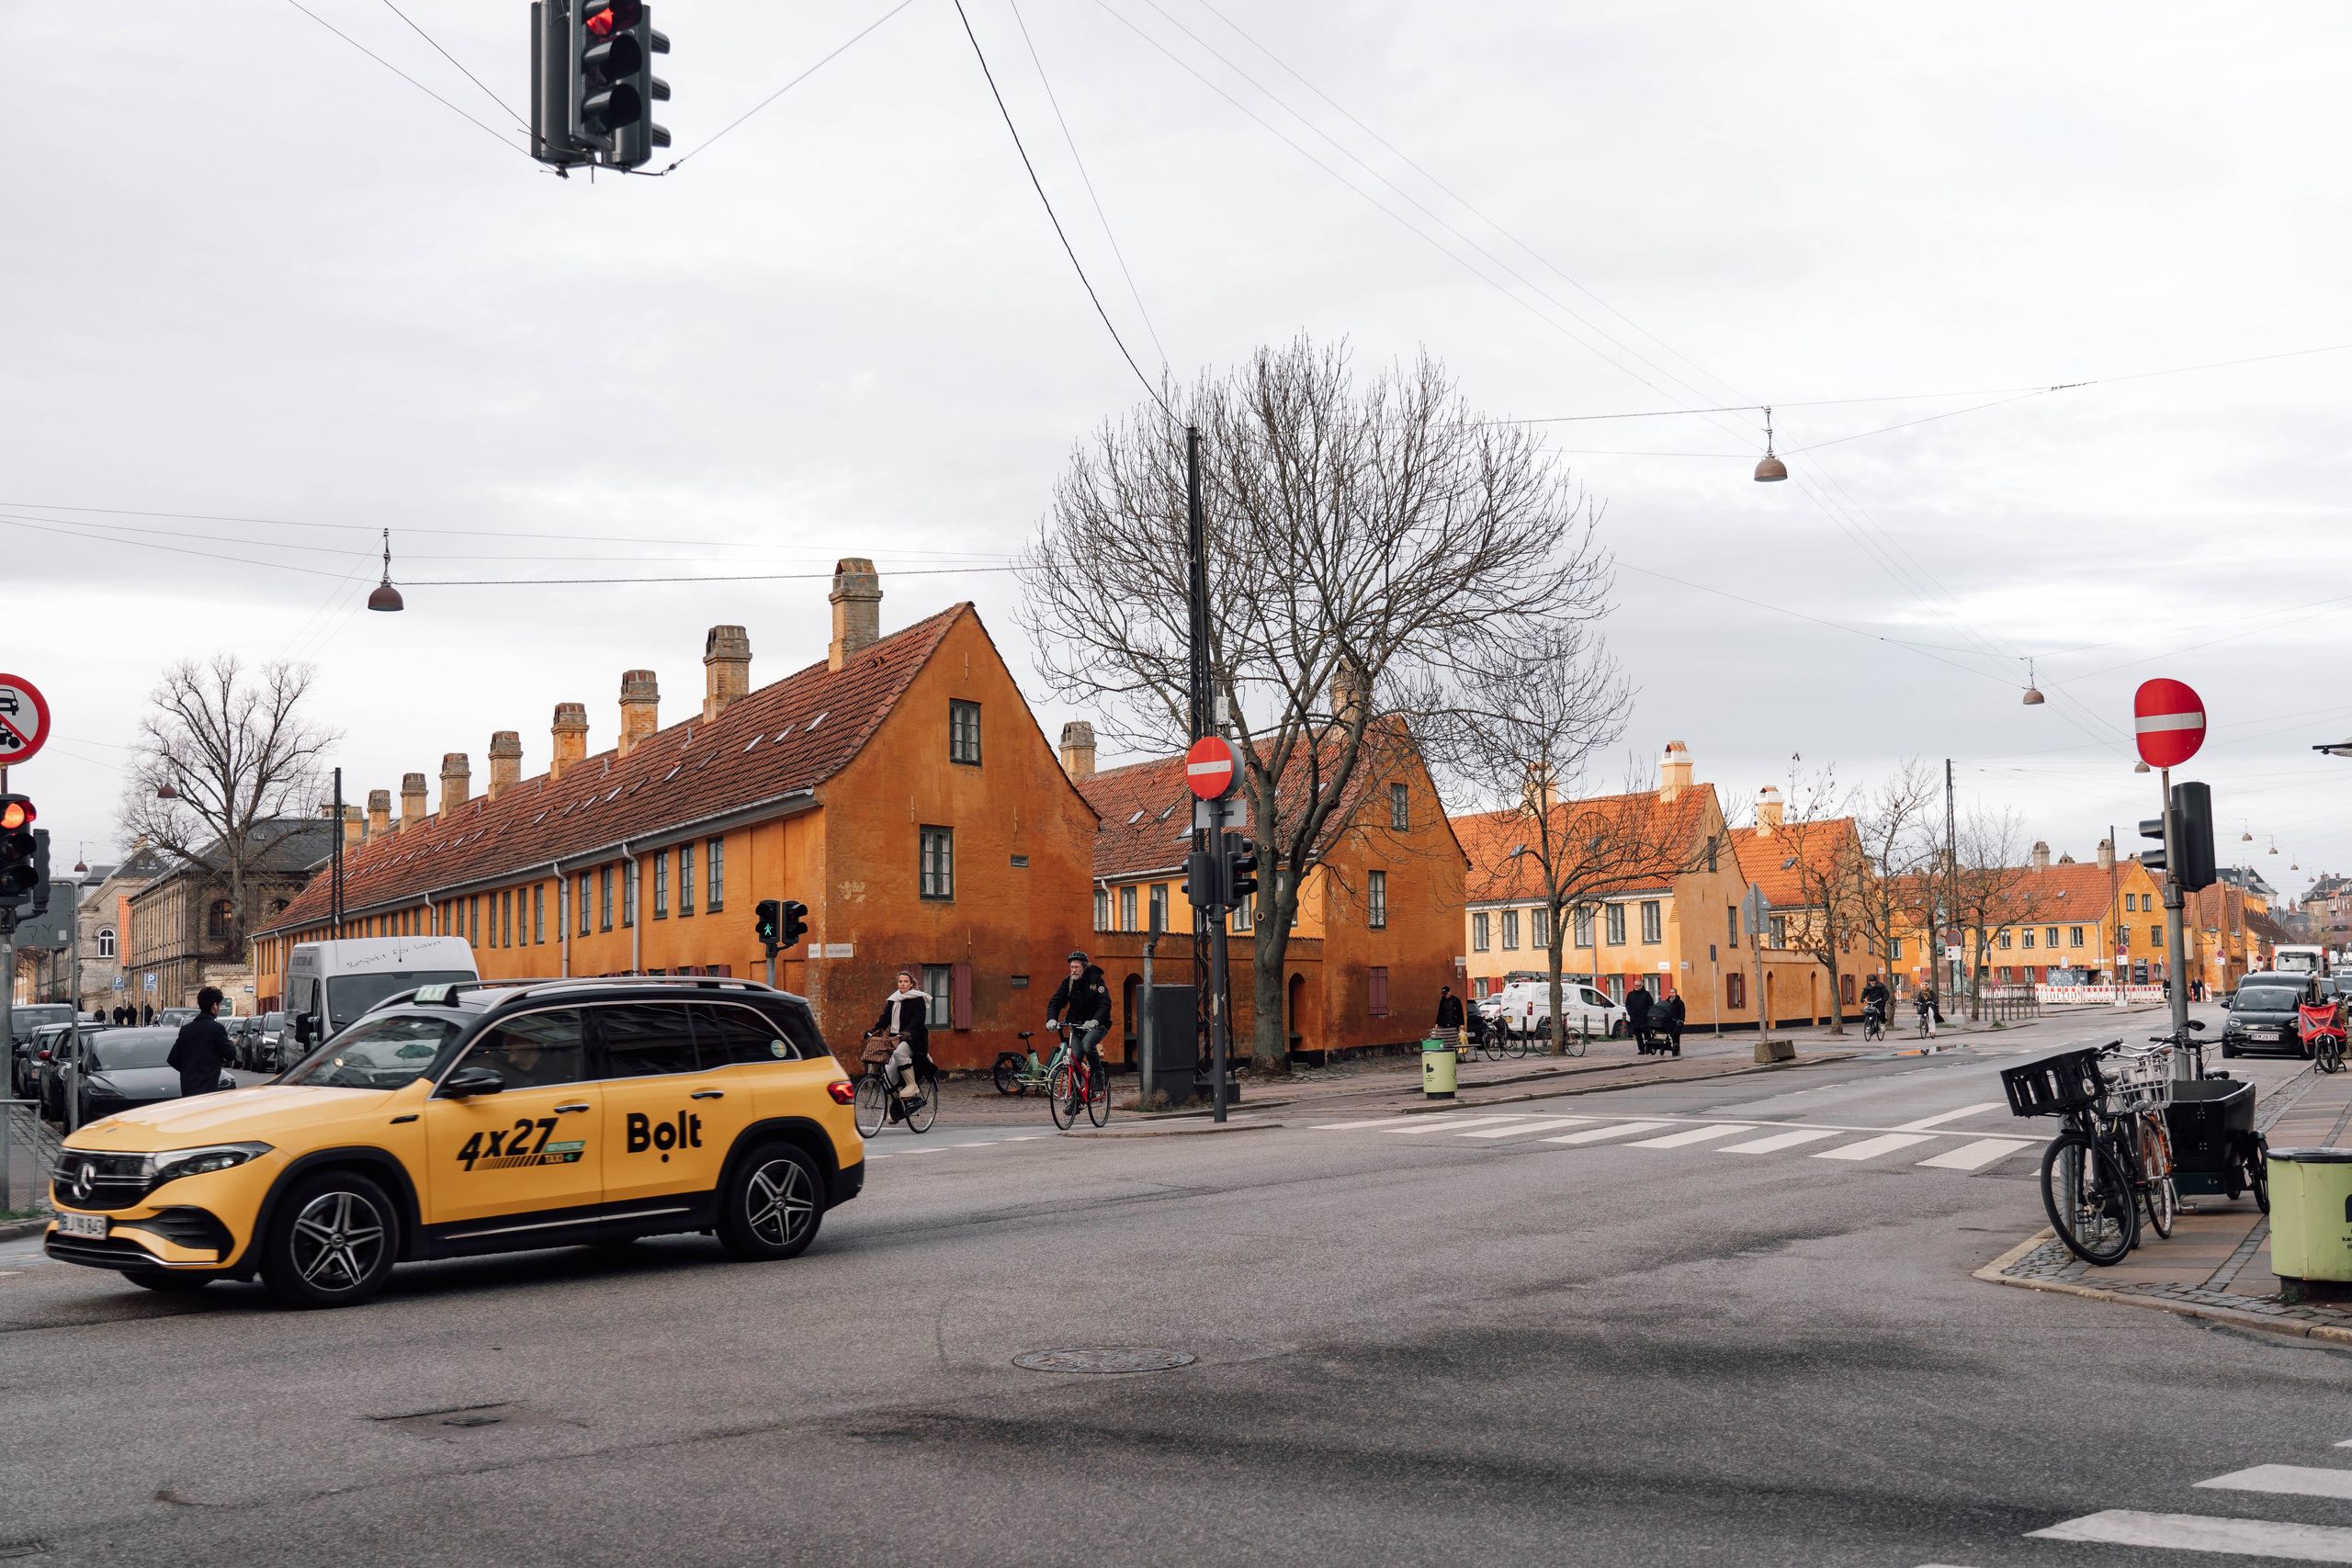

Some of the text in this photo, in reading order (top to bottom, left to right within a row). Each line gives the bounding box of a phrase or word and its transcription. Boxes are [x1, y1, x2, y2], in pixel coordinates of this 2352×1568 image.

[346, 954, 386, 968] Respekt
[148, 975, 154, 983] P
[417, 986, 448, 1001] TAXI
[627, 1110, 702, 1162] Bolt
